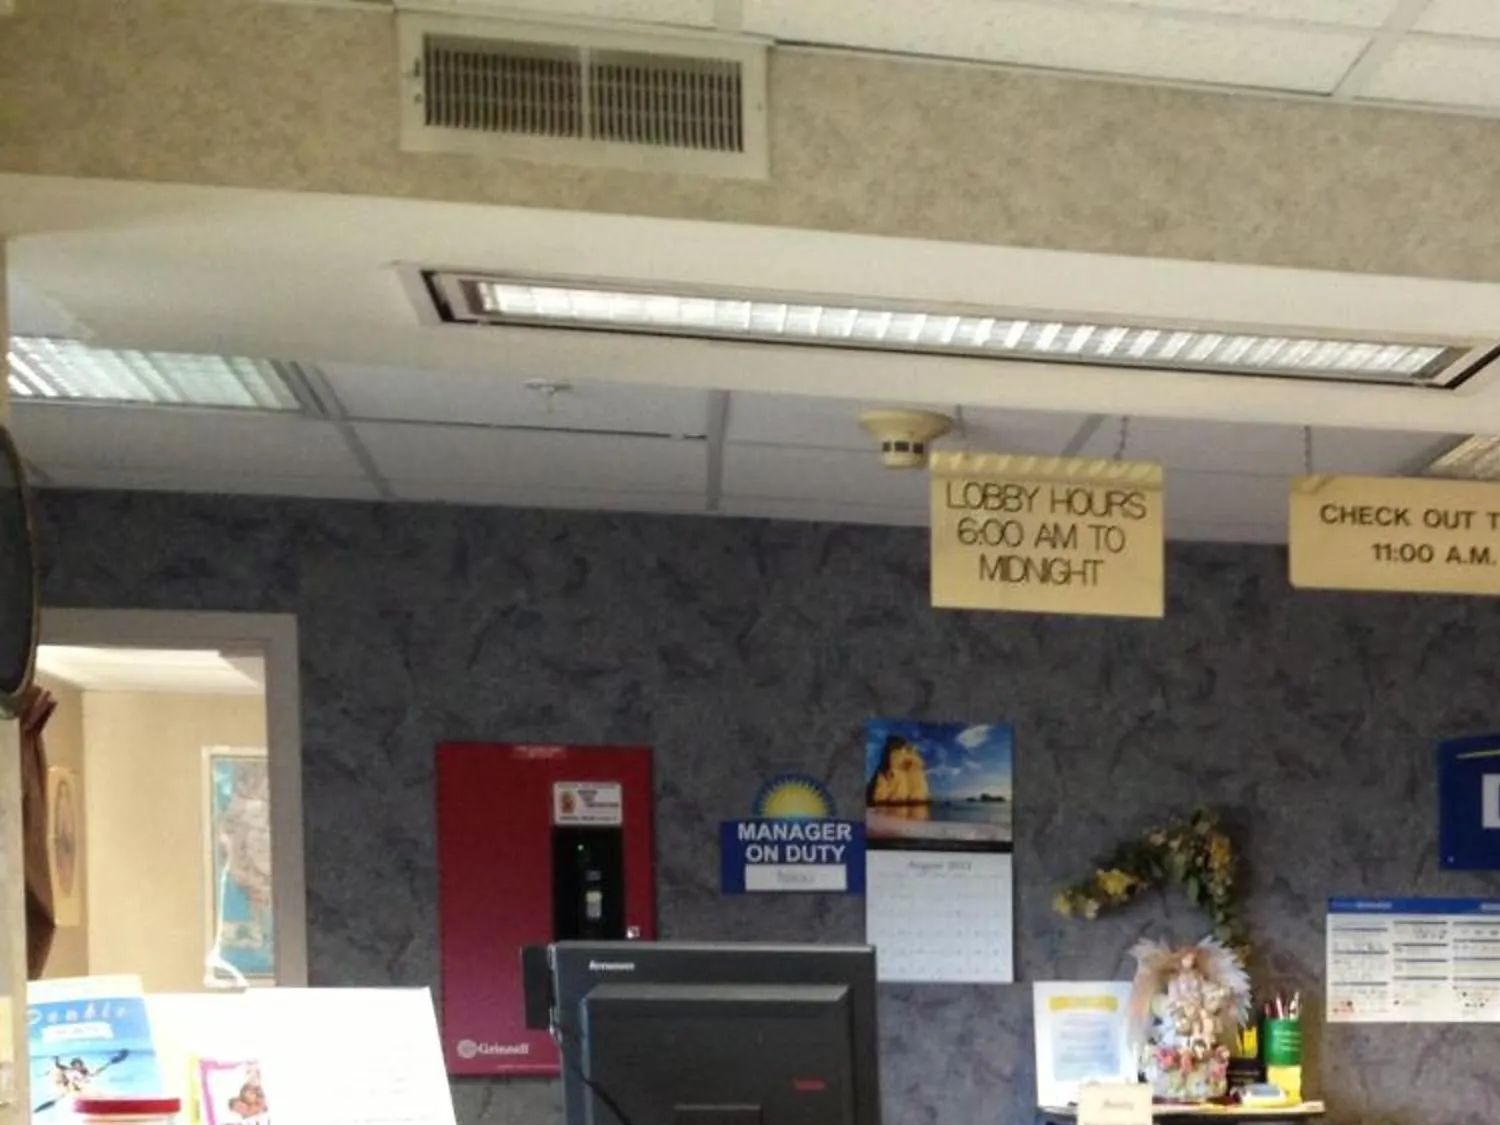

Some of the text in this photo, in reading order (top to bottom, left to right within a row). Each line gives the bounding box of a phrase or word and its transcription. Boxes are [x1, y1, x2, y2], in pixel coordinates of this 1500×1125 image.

[946, 481, 1147, 520] LOBBY HOURS
[1319, 503, 1411, 527] CHECK
[1423, 508, 1476, 531] OUT
[957, 516, 1126, 554] 6:00 AM TO
[1371, 542, 1497, 566] 11:00 A.M.
[979, 553, 1104, 587] MIDNIGHT
[737, 822, 852, 842] MANAGER
[745, 844, 846, 863] ON DUTY
